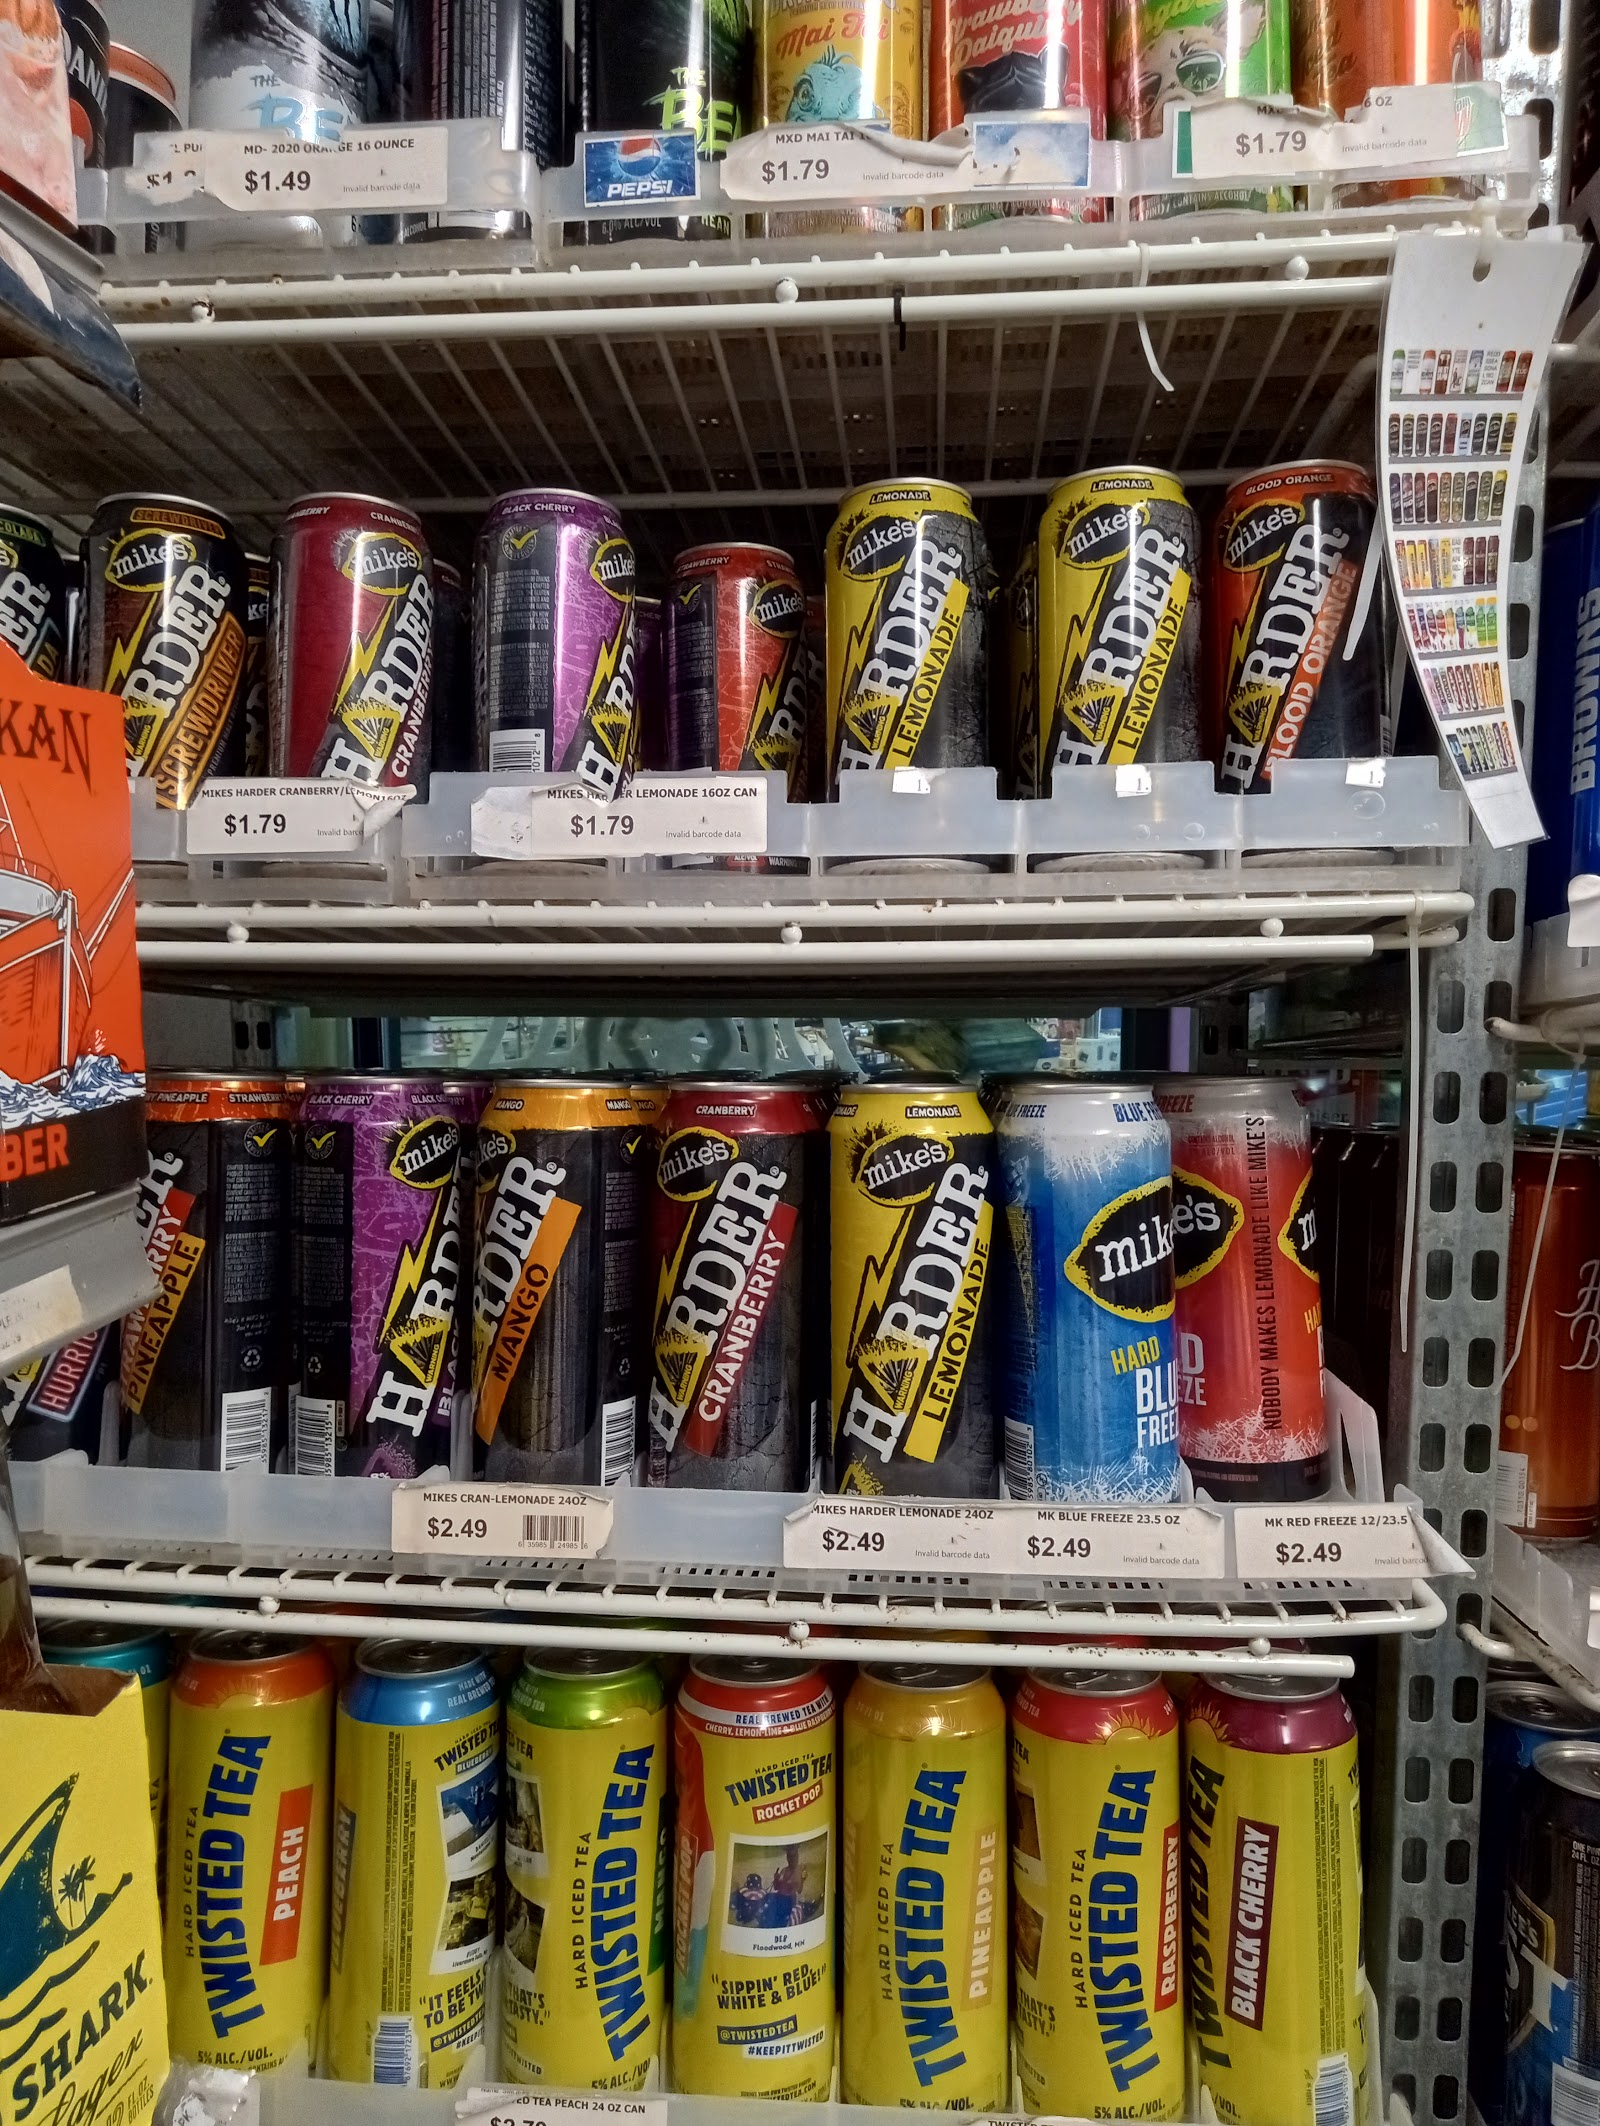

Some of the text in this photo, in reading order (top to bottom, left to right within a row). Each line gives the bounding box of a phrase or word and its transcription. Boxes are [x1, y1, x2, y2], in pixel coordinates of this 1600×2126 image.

[776, 18, 836, 59] Mai
[250, 74, 281, 88] THE
[1375, 96, 1393, 107] OZ
[244, 138, 415, 156] MD- 2020 16 OUNCE
[775, 131, 855, 144] MXD MAI TAI
[1236, 130, 1307, 156] $1.79
[244, 170, 311, 194] $1.49
[762, 158, 829, 184] $1.79
[863, 170, 944, 181] Invalid barcode data
[607, 179, 673, 198] PEPSI
[1091, 480, 1153, 491] LEMONADE
[1245, 473, 1333, 495] BLOOD ORANGE
[534, 503, 576, 514] CHERRY
[870, 492, 930, 503] LEMONADE
[848, 518, 917, 569] mike's
[1067, 508, 1142, 557] mike's
[1227, 504, 1296, 562] mike's
[112, 541, 189, 578] mike's
[1302, 562, 1358, 675] ORANGE
[893, 608, 961, 758] LEMONADE
[1117, 597, 1184, 750] LEMONADE
[1570, 586, 1600, 795] BROWNS
[157, 633, 243, 800] SCREWDRIVER
[202, 787, 276, 798] MIKES HARDER
[547, 786, 757, 799] MIKES LEMONADE 16OZ CAN
[224, 814, 287, 837] $1.79
[317, 828, 341, 837] Invalid
[571, 814, 634, 838] $1.79
[665, 829, 741, 838] Invalid barcode data
[157, 1093, 208, 1103] PINEAPPLE
[334, 1094, 373, 1105] CHERRY
[695, 1105, 756, 1117] CRANBERRY
[906, 1105, 960, 1118] LEMONADE
[1114, 1101, 1144, 1122] BLUE
[400, 1125, 459, 1176] mike's
[661, 1139, 730, 1184] mike's
[864, 1143, 947, 1190] mike's
[1246, 1117, 1282, 1430] NOBODY MAKES LEMONADE LIKE MIKE'S
[127, 1239, 200, 1403] PINEAPPLE
[493, 1263, 549, 1382] MANGO
[699, 1227, 786, 1422] CRANBERRY
[922, 1238, 990, 1423] LEMONADE
[424, 1343, 440, 1385] WARNING
[1110, 1335, 1160, 1375] HARD
[676, 1363, 693, 1402] WARNING
[893, 1370, 912, 1410] WARNING
[422, 1492, 587, 1506] MIKES CRAN-LEMONADE 24OZ
[811, 1505, 994, 1520] MIKES HARDER LEMONADE 24OZ
[1037, 1511, 1180, 1525] MK BLUE FREEZE 23.5 OZ
[1265, 1515, 1407, 1528] MK RED FREEZE 12/23.5
[427, 1517, 488, 1539] $2.49
[822, 1529, 885, 1552] $2.49
[527, 1541, 579, 1549] 35985 24985
[915, 1549, 990, 1560] Invalid barcode data
[1027, 1536, 1091, 1559] $2.49
[1276, 1542, 1342, 1564] $2.49
[1123, 1556, 1199, 1566] Invalid barcode data
[1374, 1557, 1399, 1565] Invalid
[448, 1696, 467, 1708] REAL
[736, 1703, 816, 1725] REAL TEA
[434, 1728, 488, 1771] TWISTED
[755, 1752, 815, 1774] HARD ICED TEA
[724, 1752, 833, 1806] TWISTED TEA
[756, 1784, 821, 1821] ROCKET POP
[183, 1806, 199, 1958] HARD ICED TEA
[197, 1734, 271, 2039] TWISTED TEA
[273, 1826, 304, 1922] PEACH
[573, 1832, 591, 1989] HARD ICED TEA
[590, 1743, 654, 2061] TWISTED TEA
[879, 1842, 894, 2000] HARD ICED TEA
[968, 1830, 996, 2000] PINEAPPLE
[1161, 1834, 1179, 1998] RASPBERRY
[1231, 1824, 1271, 2022] BLACK CHERRY
[890, 1769, 967, 2087] TWISTED TEA
[1070, 1848, 1089, 2009] HARD ICED TEA
[1088, 1769, 1161, 2093] TWISTED TEA
[783, 1963, 813, 1988] RED,
[447, 1975, 481, 2003] FEELS
[717, 1990, 782, 2010] WHITE &
[424, 2001, 465, 2028] TO BE
[720, 2019, 795, 2041] @TWISTEDTEA
[747, 2030, 824, 2056] #KEEPITTWISTED
[198, 2050, 212, 2064] 5%
[128, 2087, 154, 2123] BOTTLES
[533, 2097, 646, 2114] TEA PEACH 24 OZ CAN
[1094, 2105, 1111, 2119] 5%
